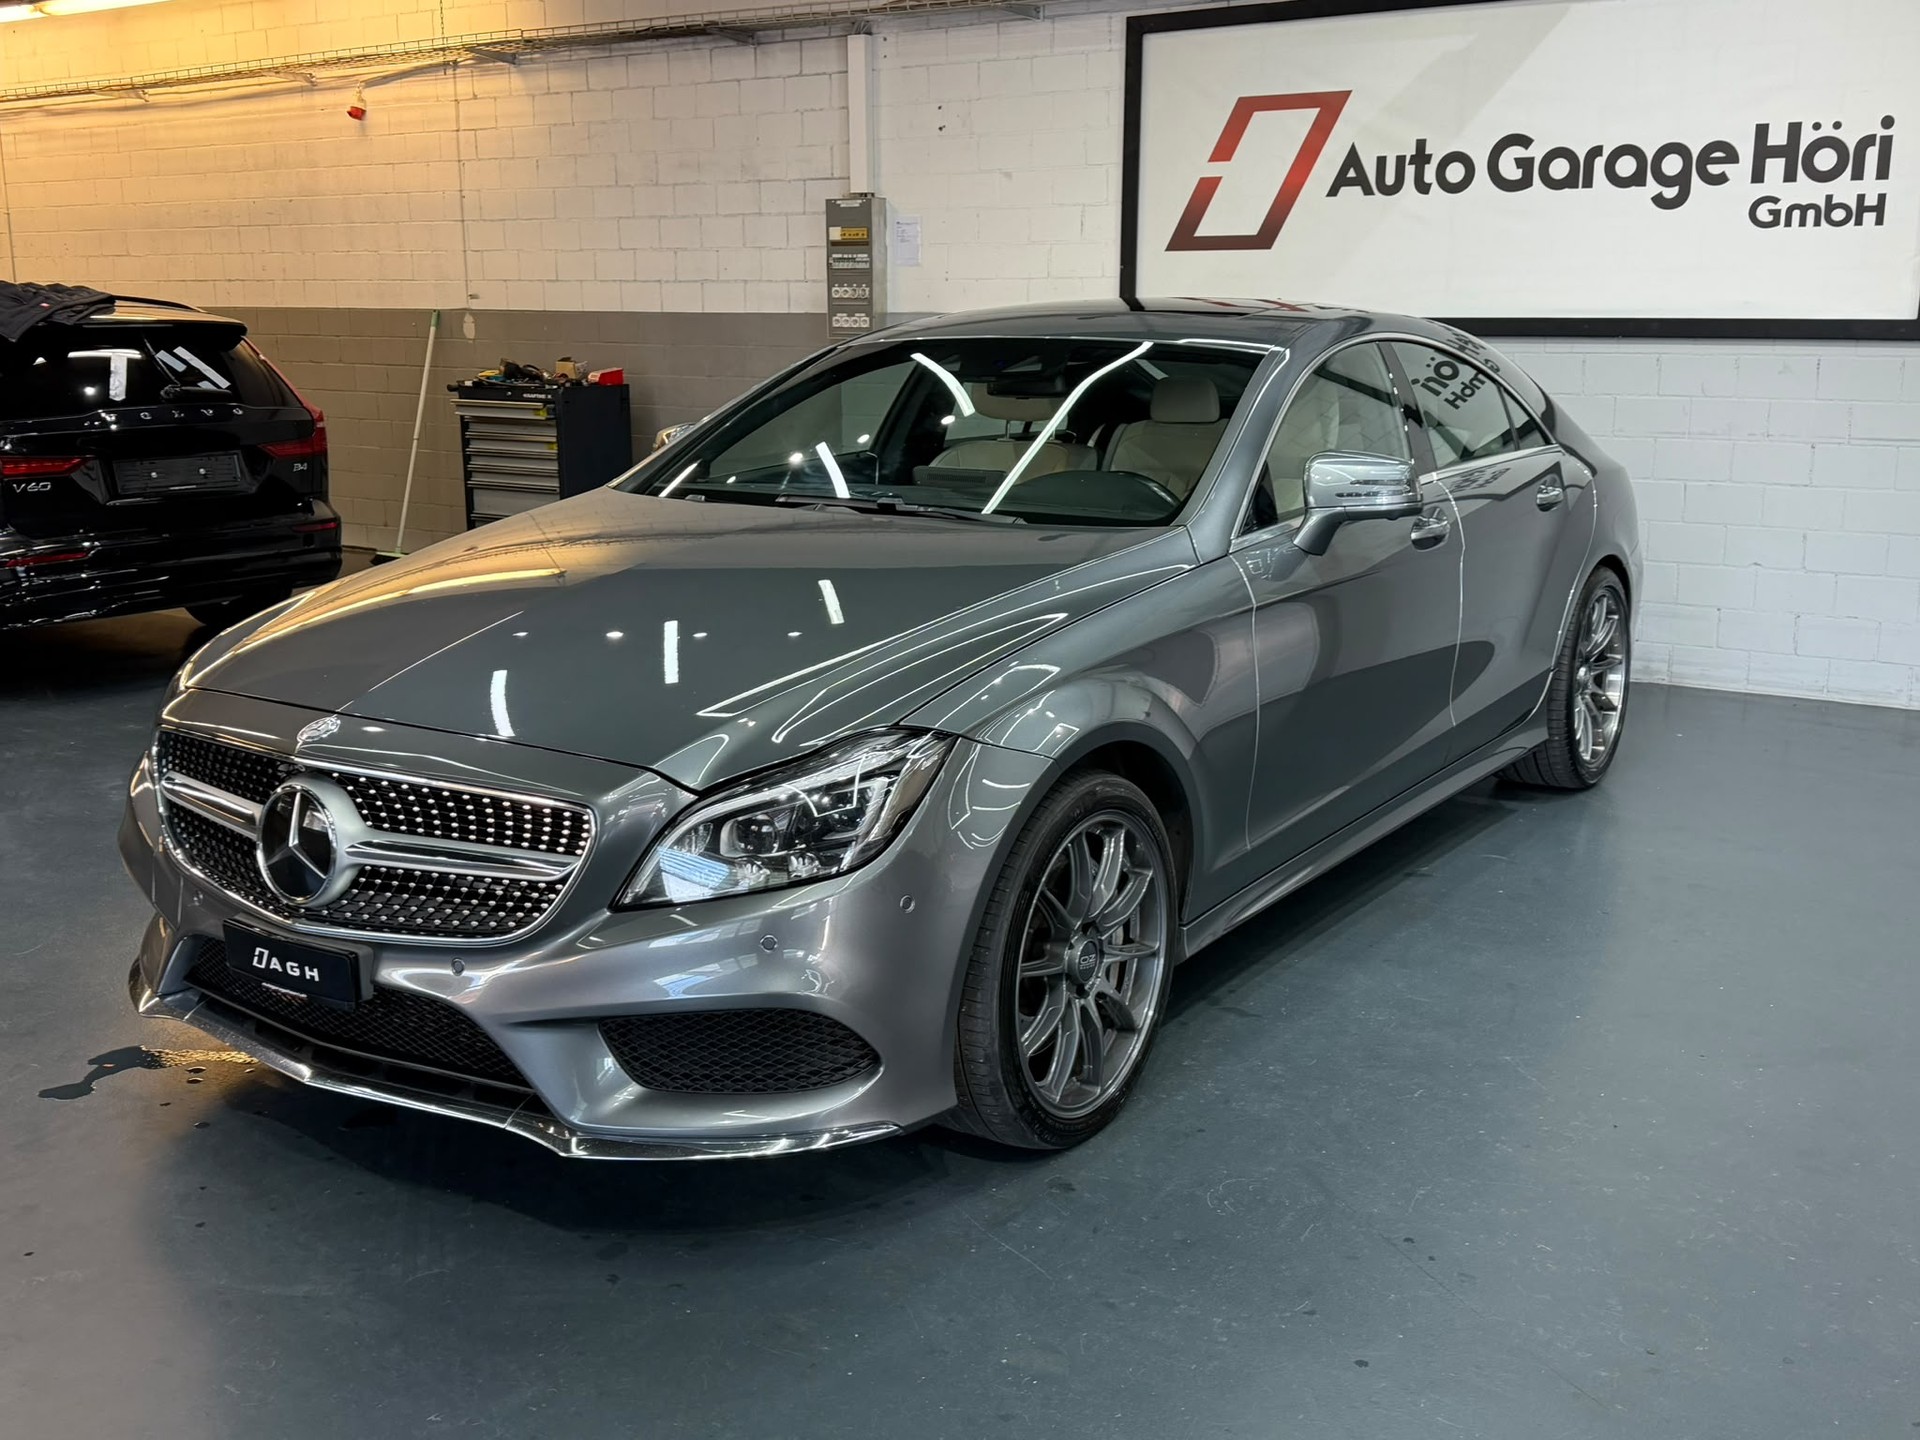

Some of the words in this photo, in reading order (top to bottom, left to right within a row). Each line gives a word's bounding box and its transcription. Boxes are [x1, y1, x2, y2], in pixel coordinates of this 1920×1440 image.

[1326, 139, 1476, 198] Auto
[1486, 133, 1740, 211] Garage
[1750, 114, 1895, 184] Höri
[1748, 192, 1887, 229] GmbH
[12, 481, 52, 493] V60
